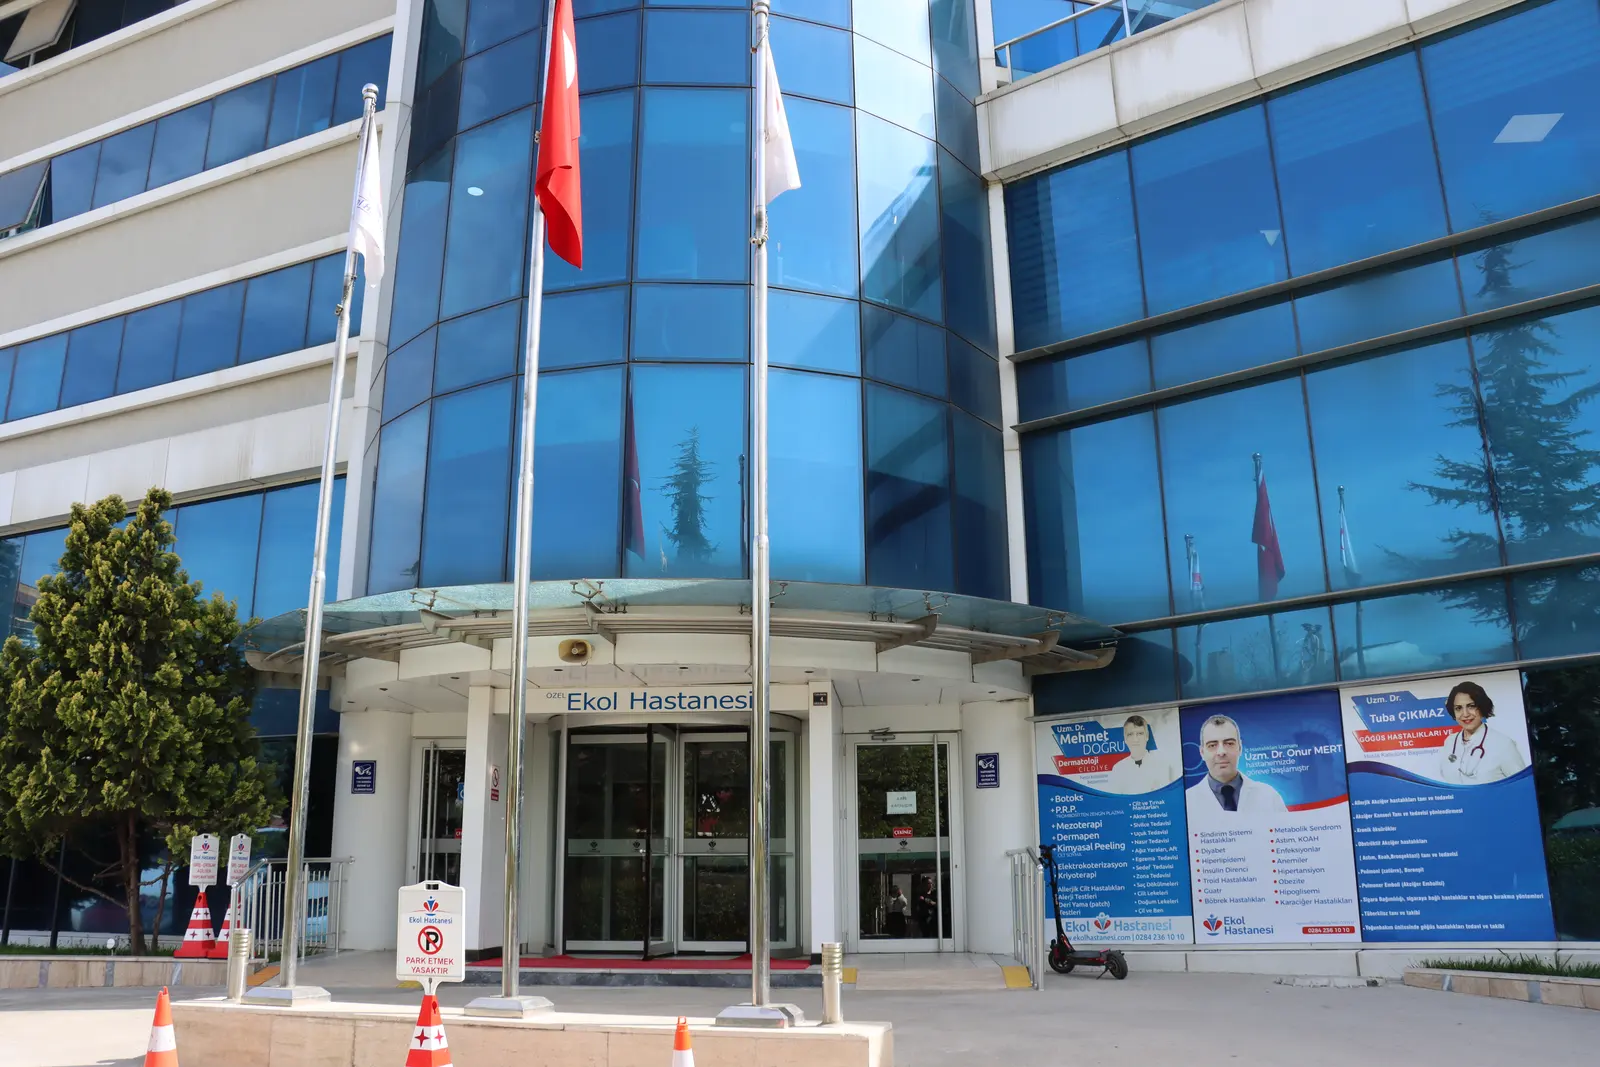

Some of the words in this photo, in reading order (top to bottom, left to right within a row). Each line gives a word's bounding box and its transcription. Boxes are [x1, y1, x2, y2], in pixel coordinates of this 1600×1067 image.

[568, 692, 617, 710] Ekol
[630, 691, 753, 710] Hastanesi
[1369, 714, 1395, 724] Tuba
[1398, 708, 1445, 722] ÇIKMAZ
[1060, 730, 1109, 744] Mehmet
[1388, 730, 1441, 740] HASTALIKLARI
[1083, 740, 1125, 755] DOĞRU
[1245, 752, 1269, 760] Uzm.
[1272, 750, 1285, 758] Dr.
[1287, 748, 1311, 757] Onur
[1314, 744, 1342, 754] MERT
[1058, 757, 1099, 767] Dermatoloji
[1246, 758, 1296, 768] hastanemizde
[1246, 768, 1269, 776] göreve
[1271, 765, 1309, 774] başlamıştır
[1055, 794, 1084, 803] Botoks
[1056, 820, 1102, 830] Mezoterapi
[1057, 833, 1099, 841] Dermapen
[1058, 843, 1093, 853] Kimyasal
[1095, 842, 1125, 851] Peeling
[1202, 856, 1245, 864] Hiperlipidemi
[1058, 862, 1128, 870] Elektrokoterizasyon
[1278, 867, 1325, 875] Hipertansiyon
[1058, 871, 1096, 880] Kriyoterapi
[1065, 921, 1090, 932] Ekol
[1114, 919, 1172, 931] Hastanesi
[1224, 916, 1245, 925] Ekol
[1224, 925, 1274, 935] Hastanesi
